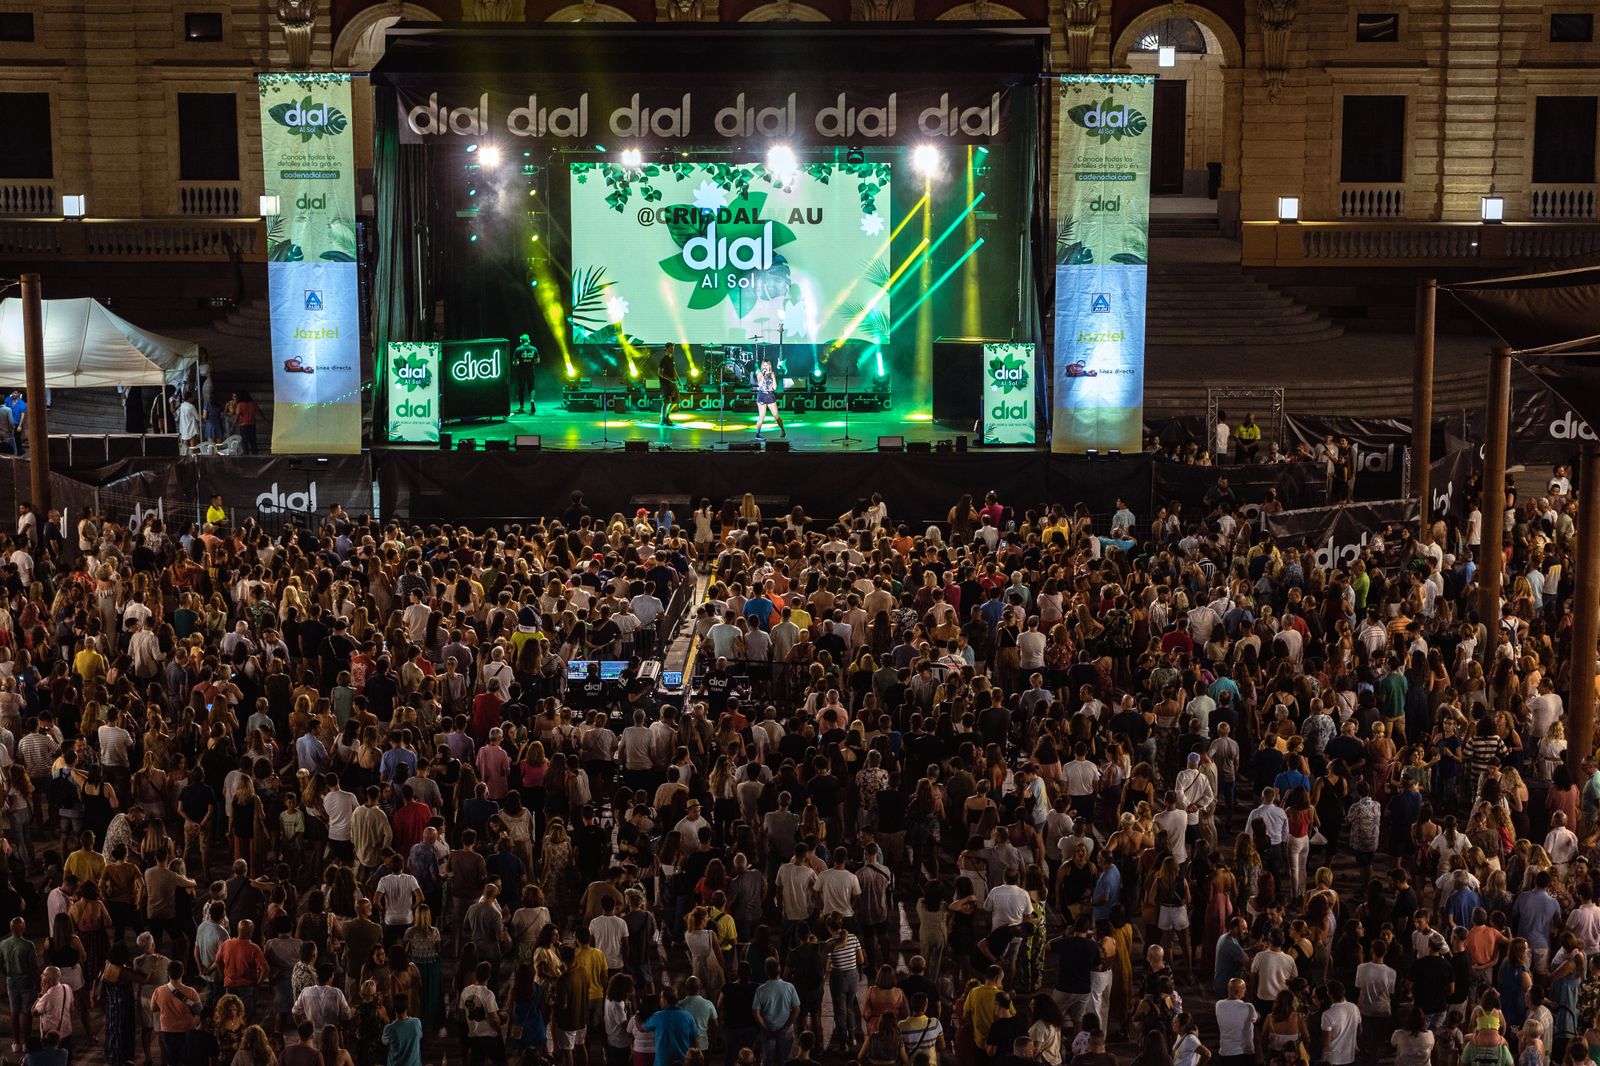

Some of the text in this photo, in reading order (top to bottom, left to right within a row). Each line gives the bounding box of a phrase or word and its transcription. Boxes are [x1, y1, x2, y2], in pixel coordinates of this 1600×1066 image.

[285, 101, 328, 126] dial
[408, 91, 999, 137] dial dial dial dial dial dial
[1084, 102, 1128, 127] dial
[296, 193, 326, 209] dial
[1089, 195, 1120, 211] dial
[682, 221, 772, 270] dial
[701, 273, 755, 288] Al Sol
[293, 326, 339, 339] Jazztel
[1076, 330, 1125, 342] Jazztel
[398, 363, 426, 378] dial
[452, 350, 500, 380] dial
[995, 364, 1022, 379] dial
[395, 399, 431, 418] dial
[992, 400, 1028, 419] dial
[1550, 411, 1598, 440] dia
[256, 482, 317, 513] dial
[584, 682, 602, 691] dial
[708, 677, 727, 687] dial
